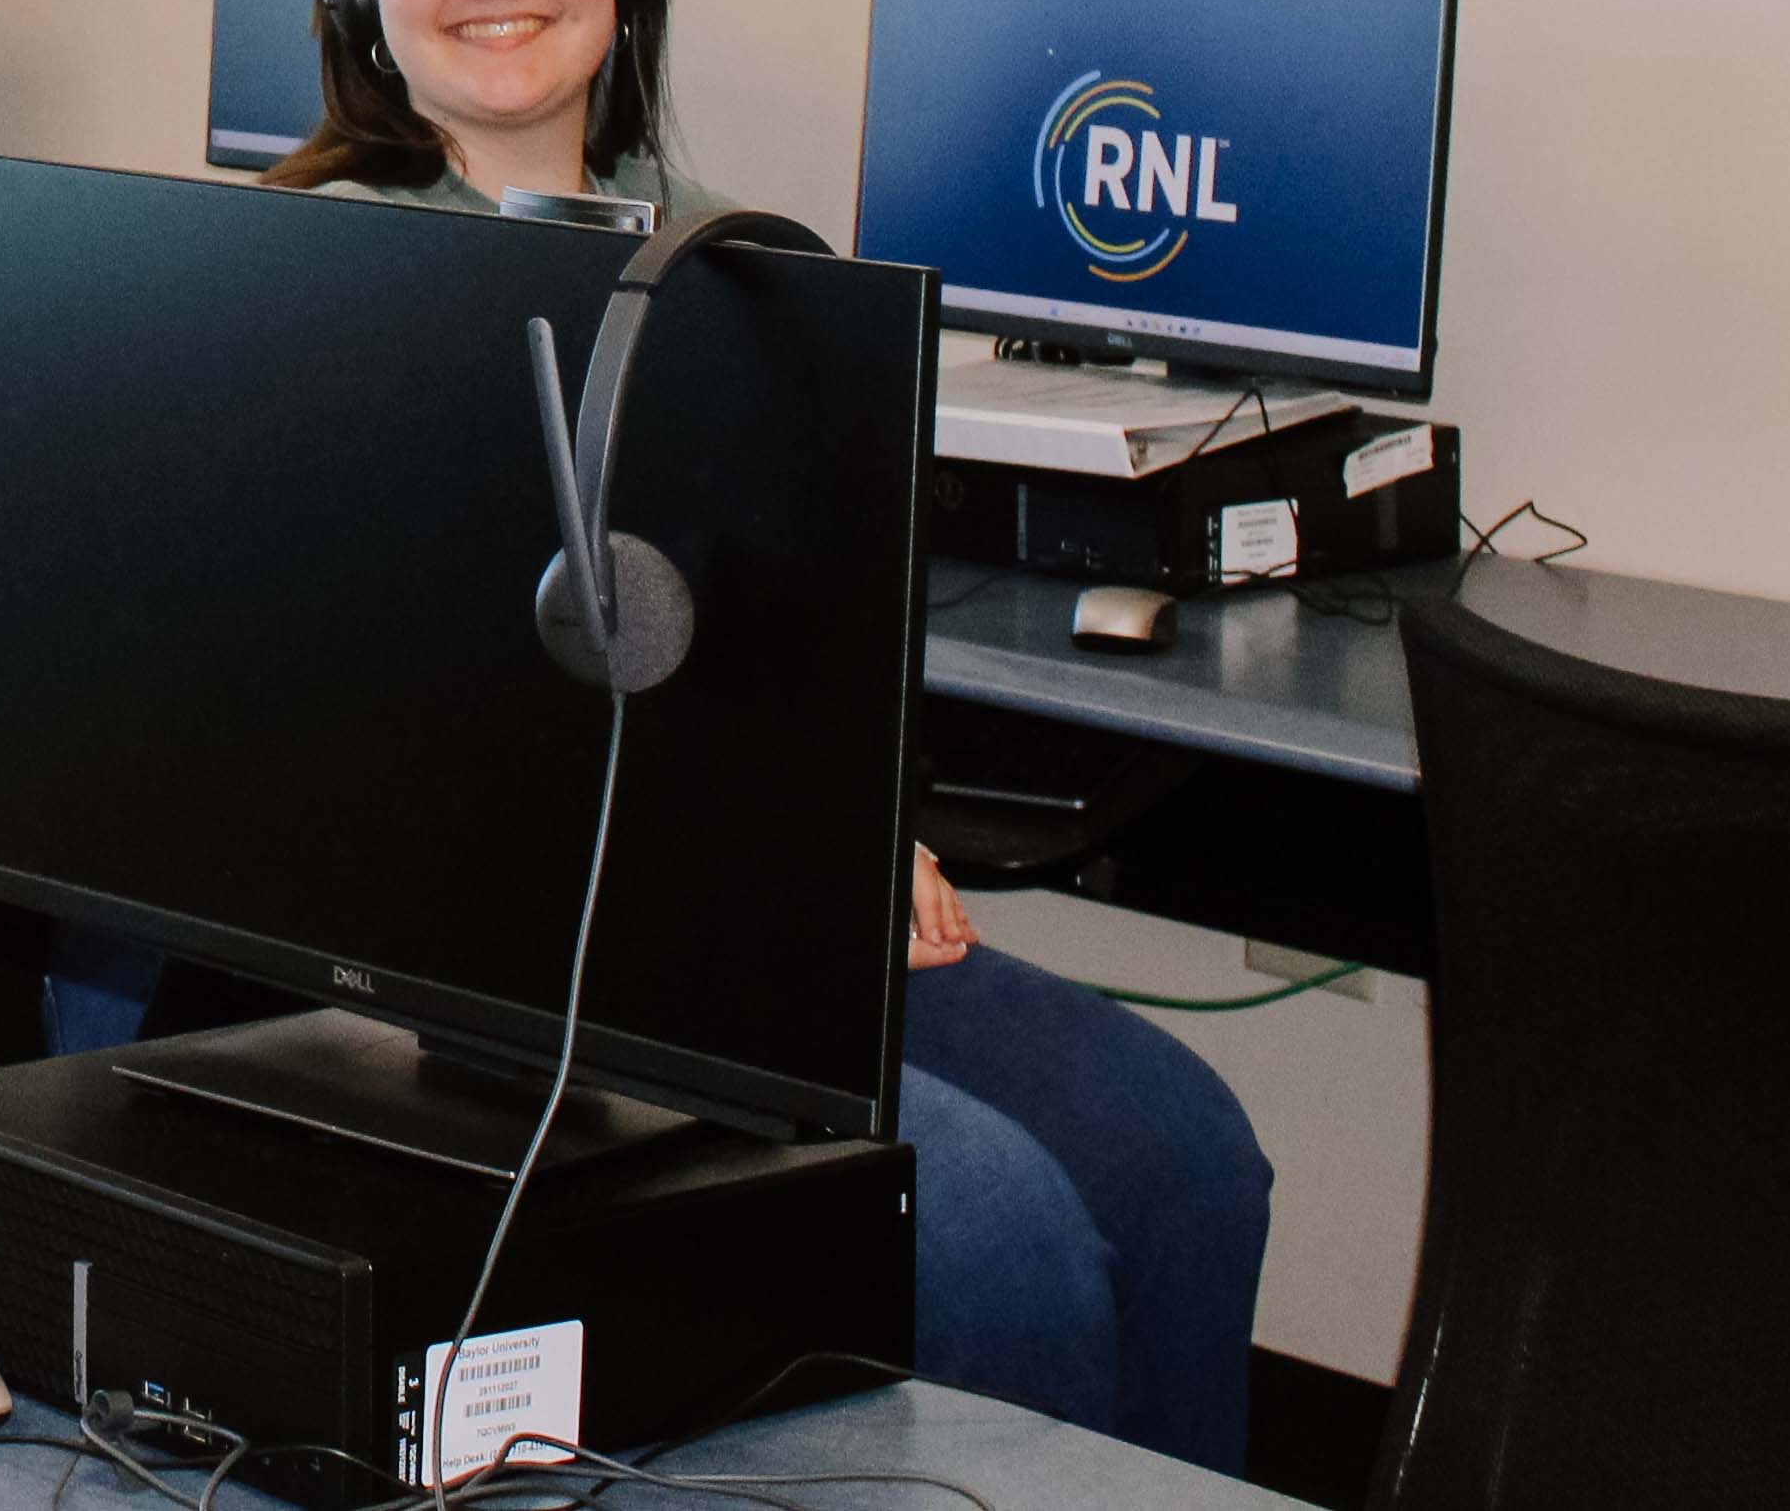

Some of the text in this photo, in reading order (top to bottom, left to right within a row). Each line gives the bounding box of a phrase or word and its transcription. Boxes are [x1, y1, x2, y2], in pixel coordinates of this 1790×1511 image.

[1084, 124, 1238, 223] RNL
[332, 965, 376, 994] DELL
[459, 1336, 540, 1360] Baylor University
